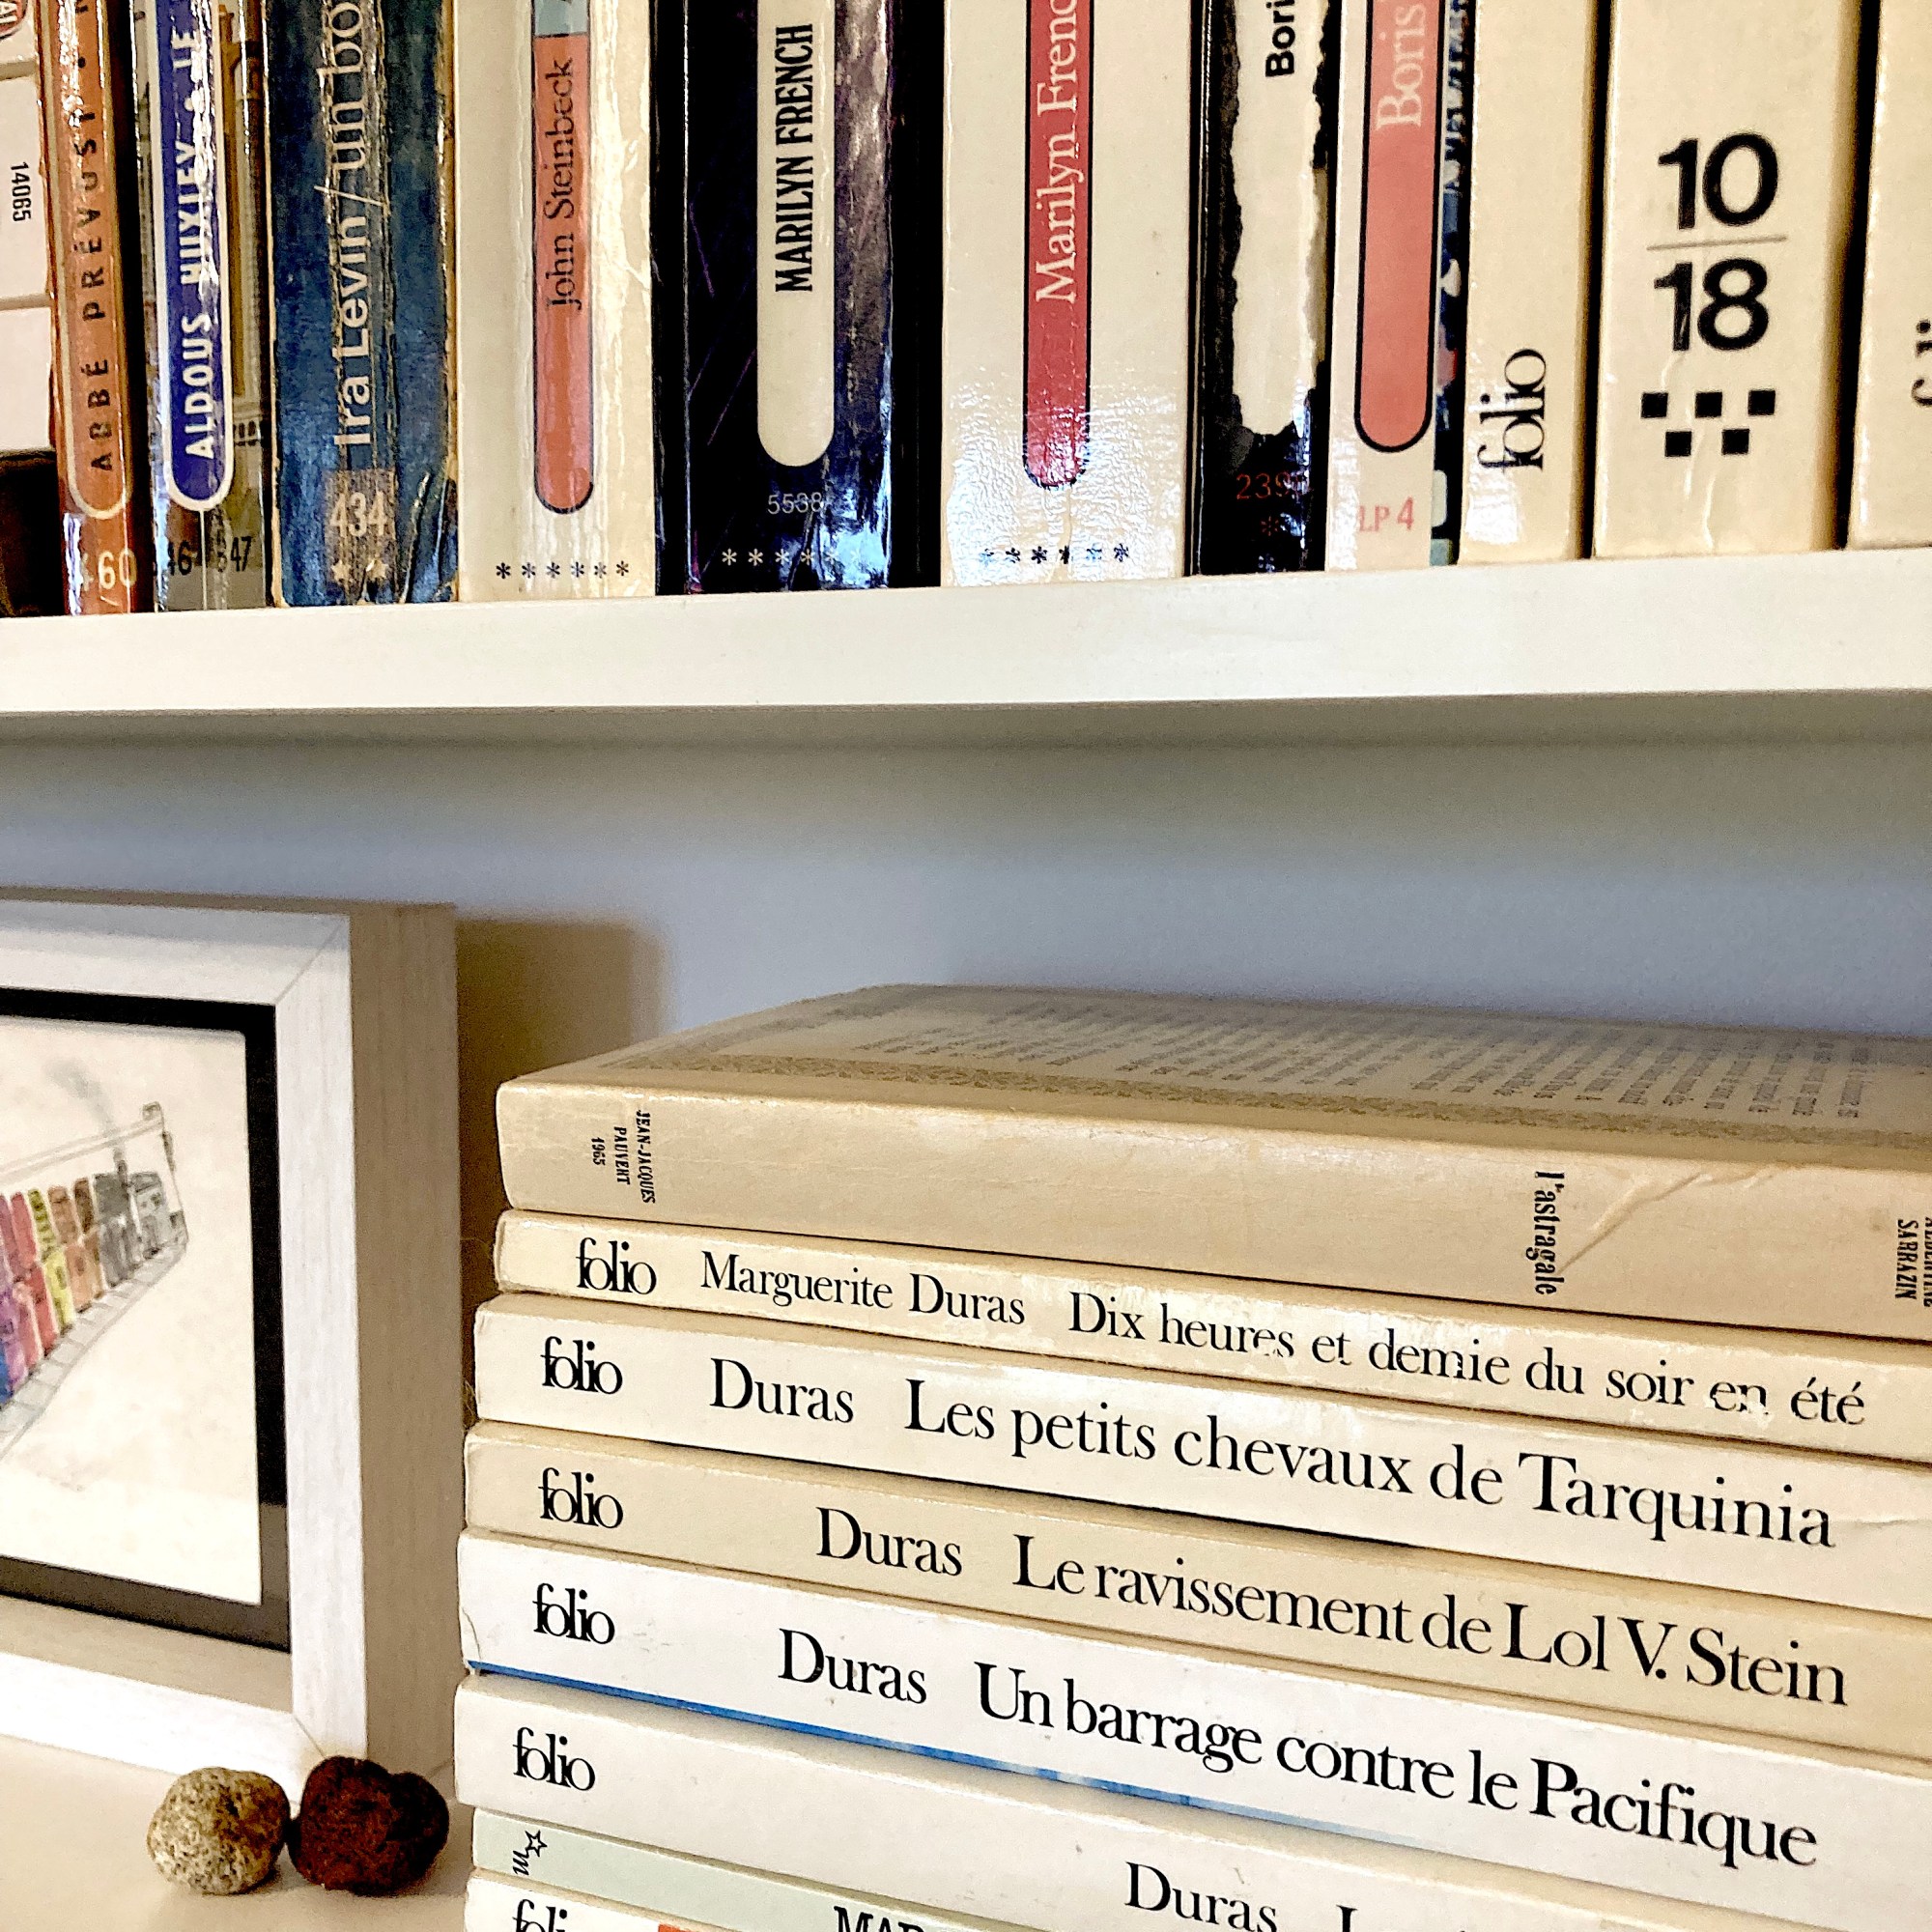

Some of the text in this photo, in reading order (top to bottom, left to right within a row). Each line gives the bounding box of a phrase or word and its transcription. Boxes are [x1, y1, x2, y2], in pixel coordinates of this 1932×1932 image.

[1376, 3, 1427, 131] Boris
[331, 100, 366, 170] un
[775, 24, 813, 292] MARILYN FRENCH
[1659, 132, 1778, 230] 10
[11, 161, 32, 223] 14065
[543, 58, 582, 310] John Steinbeck
[1035, 127, 1085, 304] Marilyn
[331, 214, 371, 357] Levin
[1654, 258, 1769, 351] 18
[77, 357, 114, 471] ABBÉ
[181, 314, 215, 461] ALDOUS
[334, 375, 372, 444] Ira
[1477, 349, 1546, 469] folio
[329, 490, 387, 538] 434
[1397, 496, 1415, 531] 4
[591, 1137, 606, 1165] 1965
[614, 1127, 630, 1184] PAUVERT
[637, 1110, 655, 1203] JEAN-JACQUES
[576, 1237, 656, 1294] folio
[1526, 1172, 1564, 1294] l'astragale
[1895, 1219, 1918, 1299] SARRAZIN
[541, 1336, 622, 1394] folio
[701, 1251, 1863, 1425] Marguerite Duras Dix heures et demie du soir en été
[538, 1467, 623, 1528] folio
[710, 1358, 1834, 1548] Duras Les petits chevaux de Tarquinia
[532, 1583, 614, 1644] folio
[816, 1507, 1847, 1706] Duras Le ravissement de Lol V. Stein
[513, 1727, 595, 1791] folio
[778, 1629, 1816, 1869] Duras Un barrage contre le Pacifique
[1125, 1862, 1277, 1932] Duras
